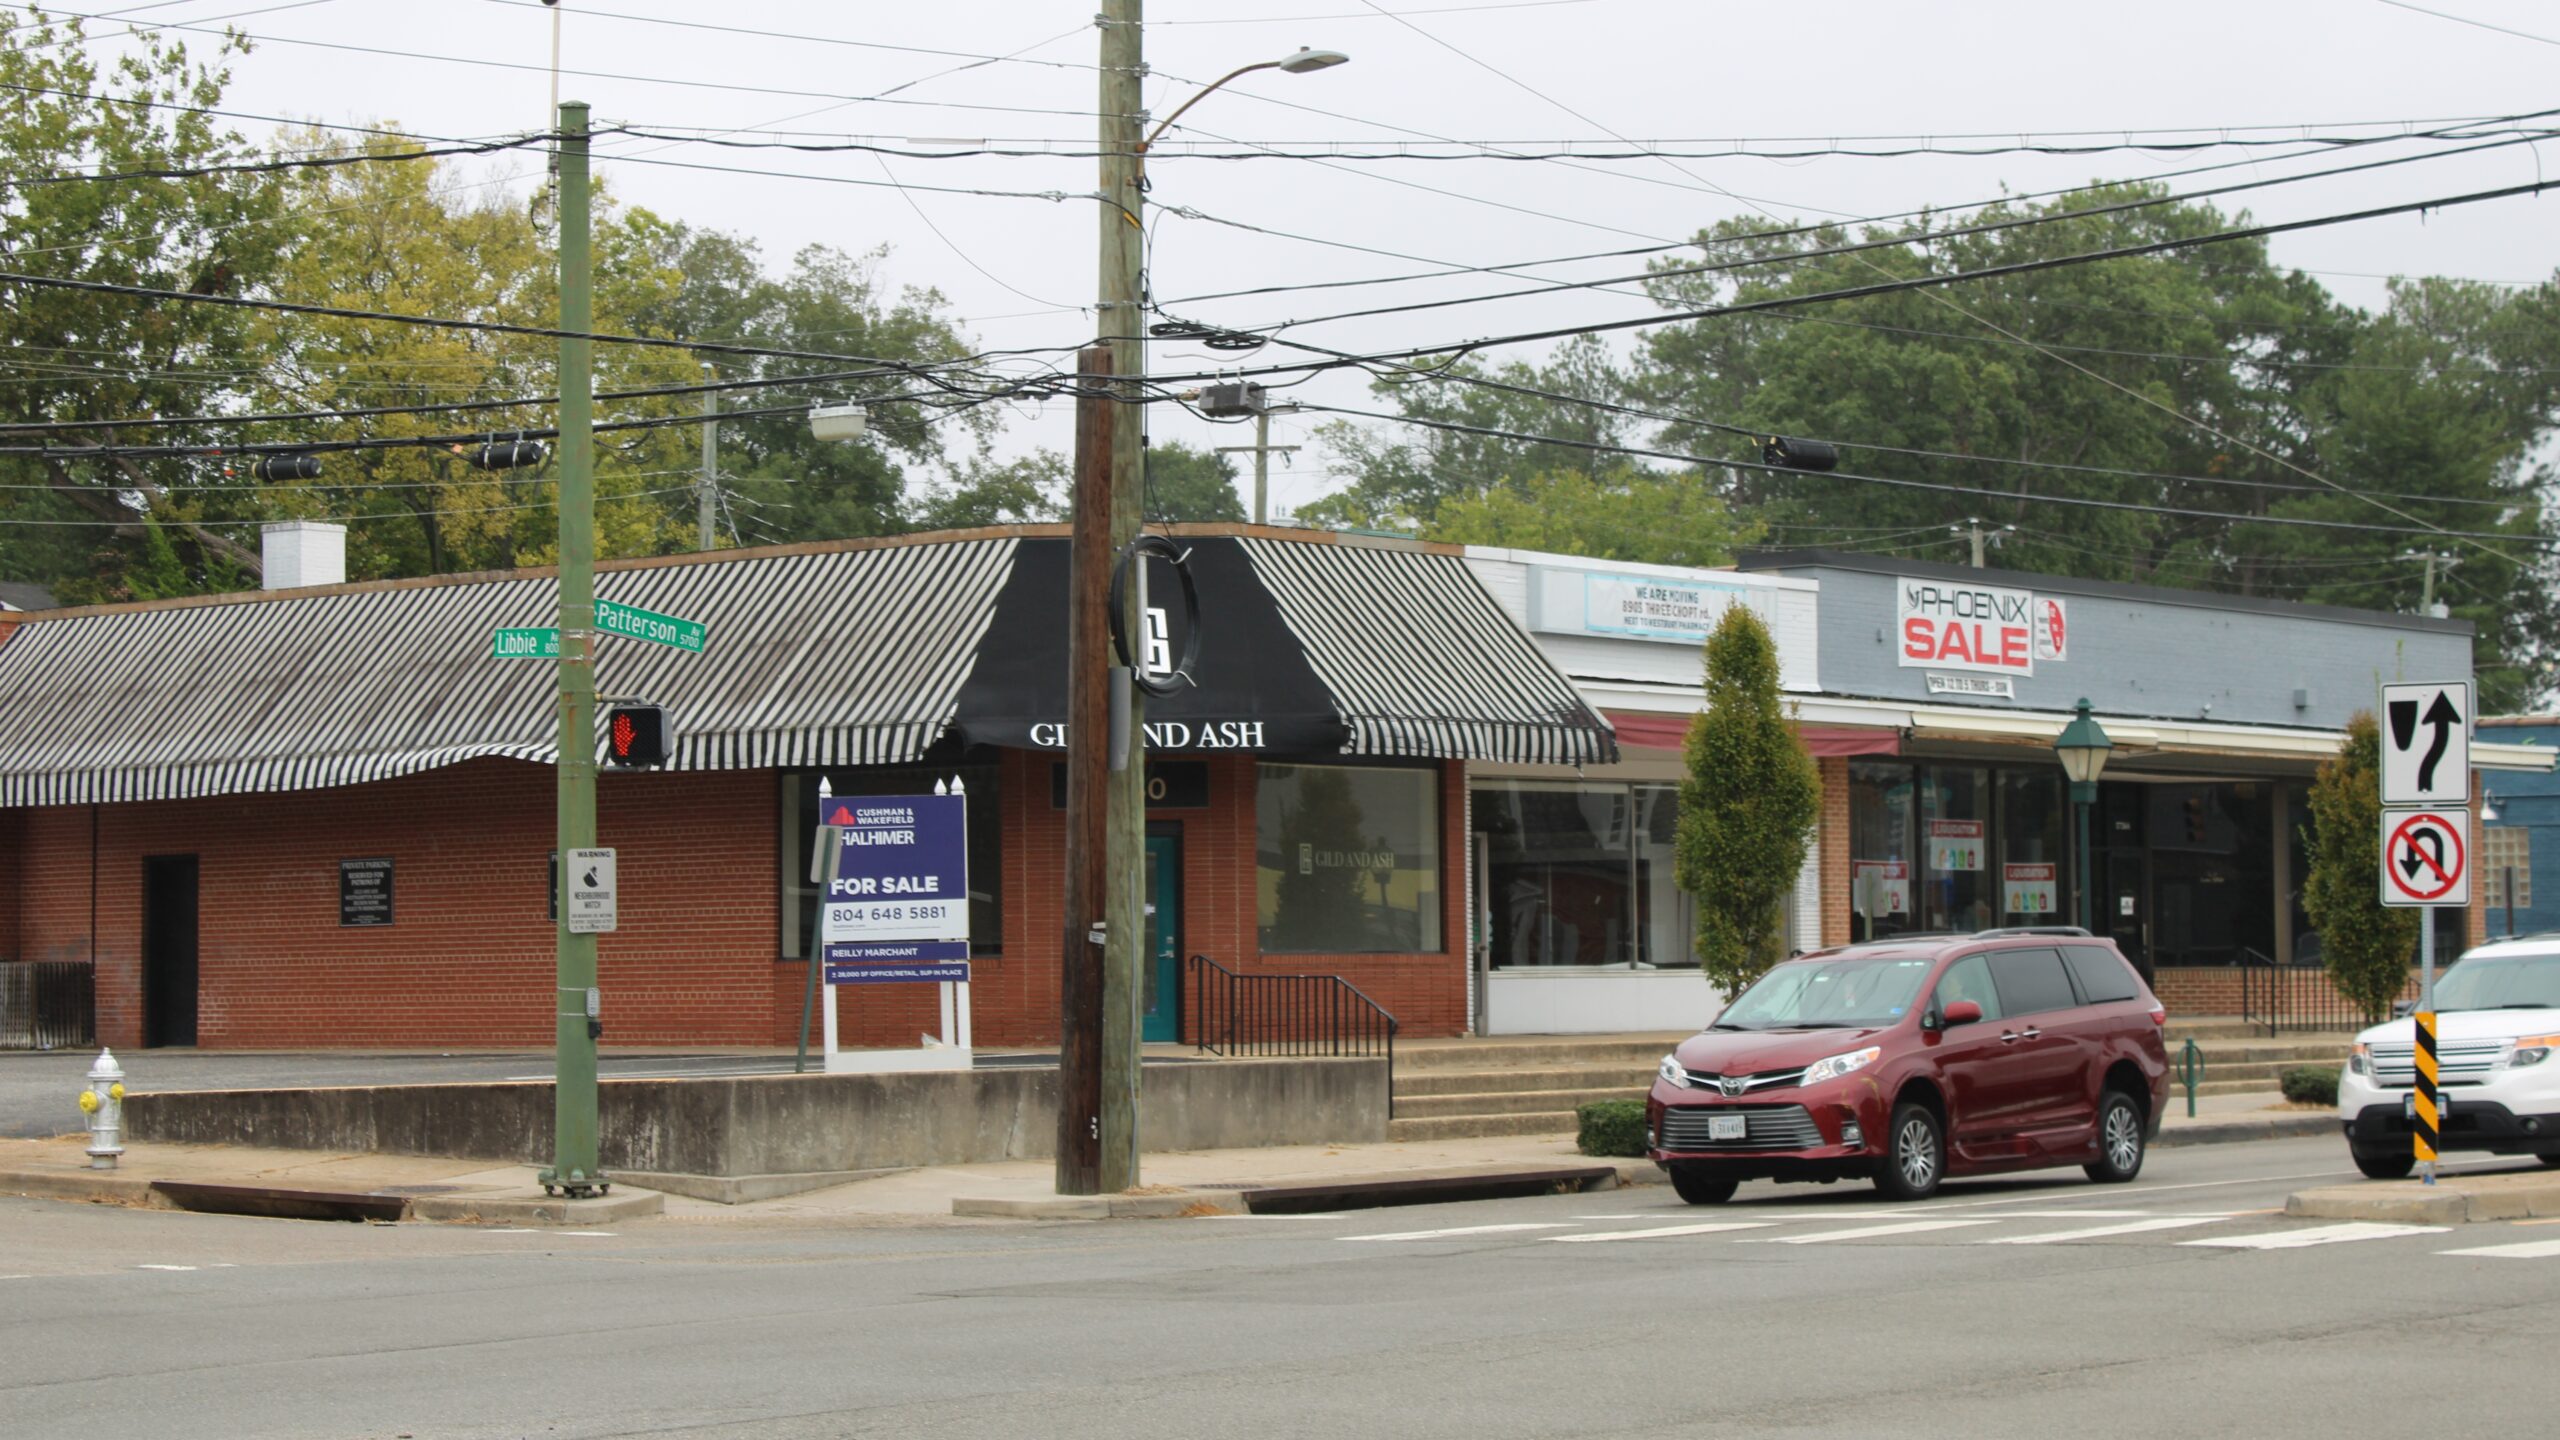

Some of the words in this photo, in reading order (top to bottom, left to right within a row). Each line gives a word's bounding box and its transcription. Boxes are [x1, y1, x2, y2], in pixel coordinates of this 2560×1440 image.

[1635, 587, 1648, 599] WE
[1650, 588, 1667, 601] ARE
[1667, 590, 1699, 604] MOVING
[1645, 602, 1672, 616] THREE
[1921, 587, 2027, 623] PHOENIX
[597, 603, 677, 643] Patterson
[691, 626, 700, 637] Av
[497, 632, 537, 654] Libbie
[544, 643, 559, 654] 800
[679, 634, 700, 648] 5700
[1904, 618, 2028, 667] SALE
[1030, 723, 1069, 748] GI
[1142, 722, 1191, 748] ND
[1196, 721, 1266, 748] ASH
[856, 808, 905, 816] CUSHMAN
[906, 807, 914, 816] &
[857, 816, 915, 824] WAKEFIELD
[841, 830, 915, 846] HALHIMER
[1315, 851, 1344, 867] GILD
[1345, 851, 1370, 867] AND
[1371, 851, 1394, 868] ASH
[831, 877, 877, 895] FOR
[881, 876, 939, 894] SALE
[833, 909, 864, 921] 804
[871, 908, 902, 920] 648
[910, 906, 946, 919] 5881
[832, 949, 863, 958] REILLY
[865, 948, 918, 957] MARCHANT
